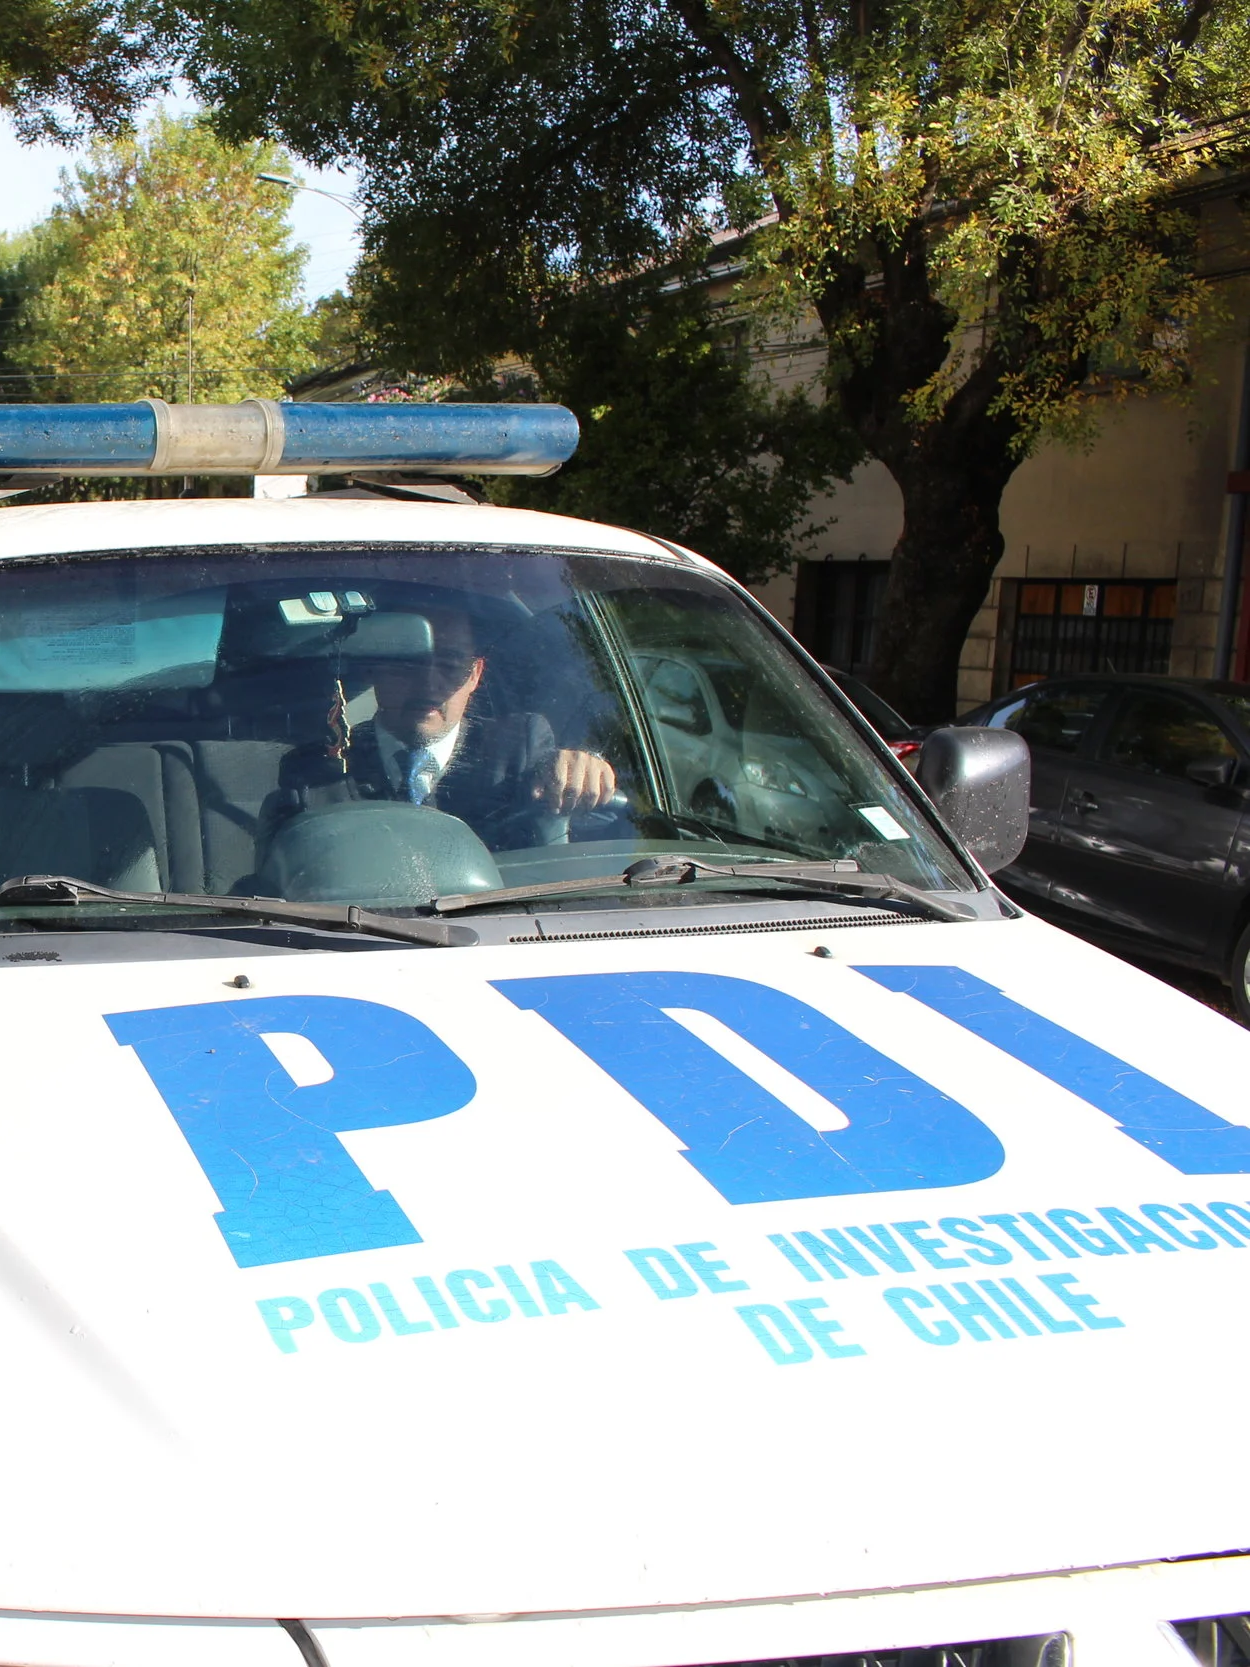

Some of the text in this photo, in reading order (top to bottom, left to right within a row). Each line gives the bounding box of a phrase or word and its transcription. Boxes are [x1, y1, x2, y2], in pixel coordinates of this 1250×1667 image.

[102, 965, 1250, 1267] PDI
[255, 1200, 1250, 1354] POLICIA DE INVESTIGACIO
[733, 1272, 1126, 1365] DE CHILE
